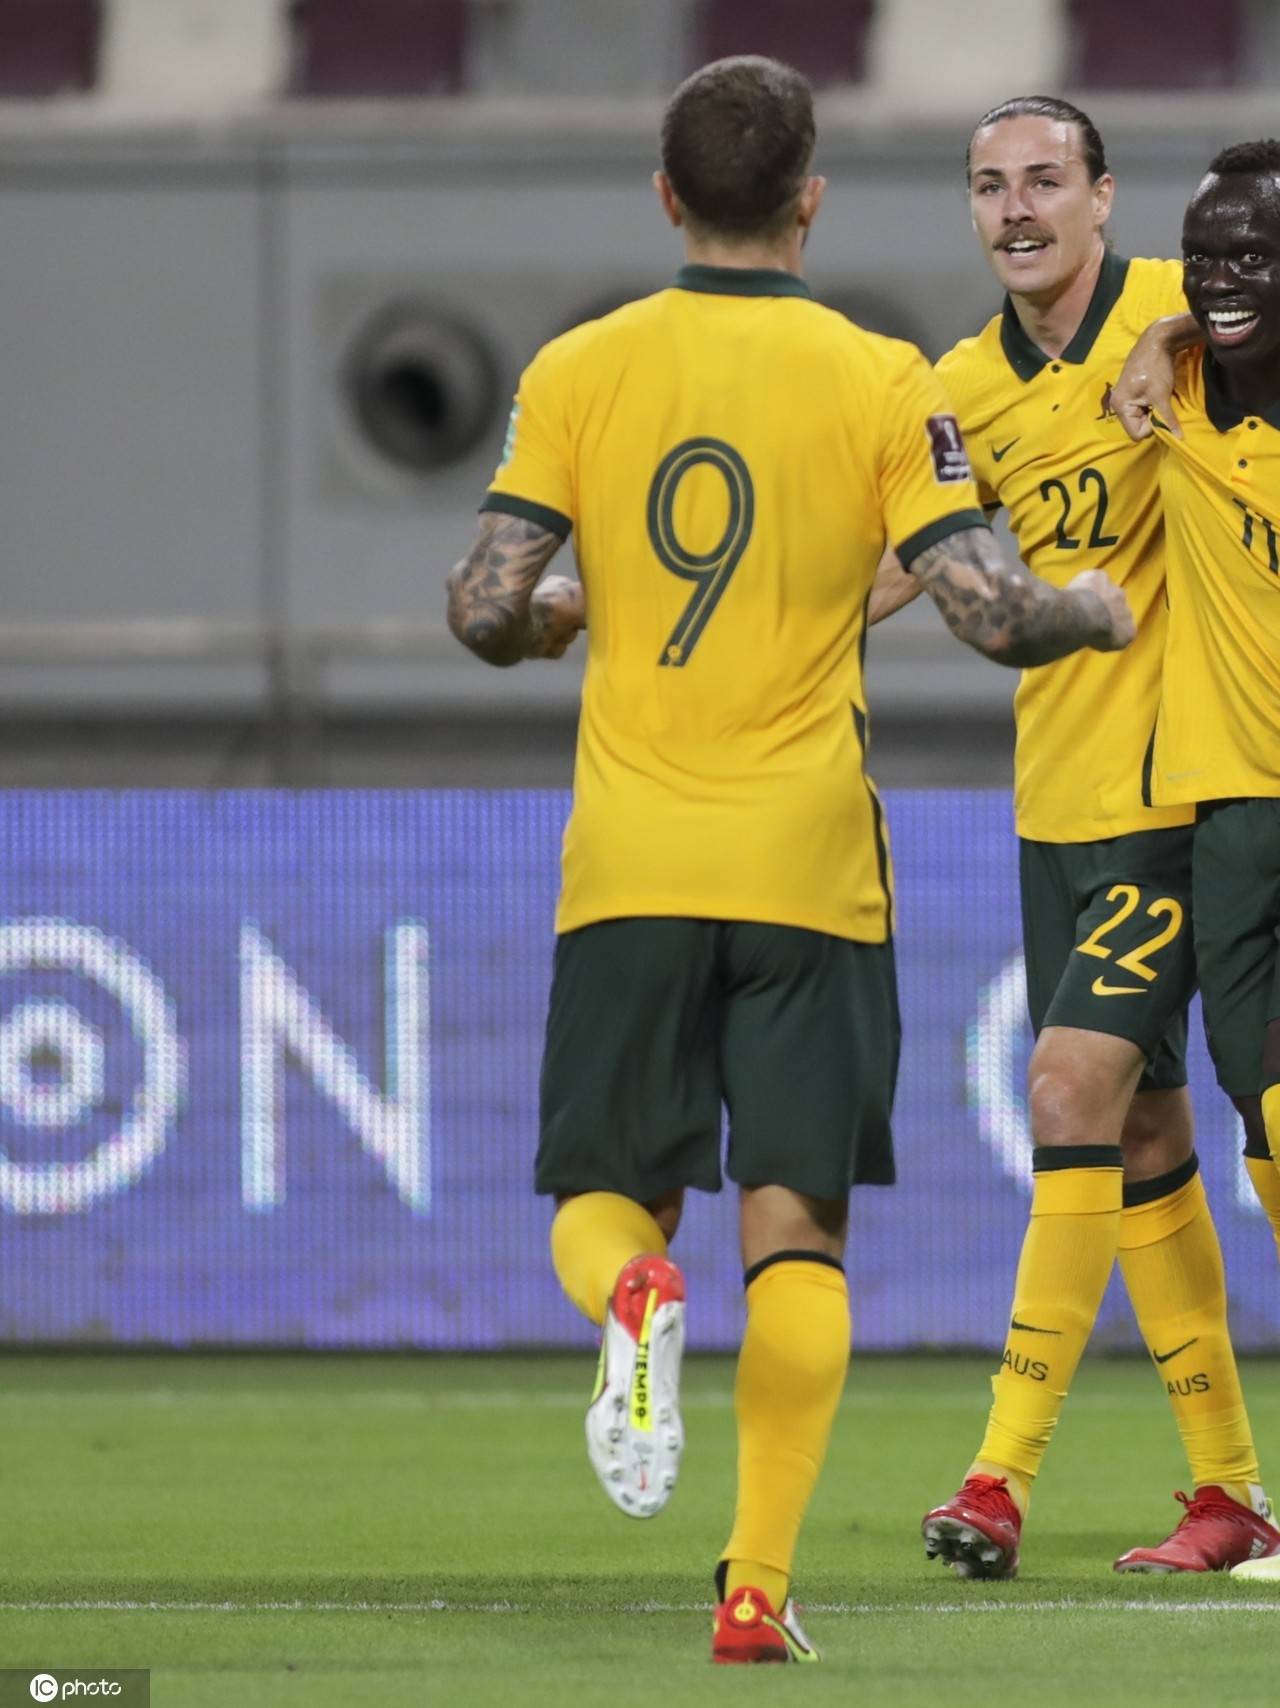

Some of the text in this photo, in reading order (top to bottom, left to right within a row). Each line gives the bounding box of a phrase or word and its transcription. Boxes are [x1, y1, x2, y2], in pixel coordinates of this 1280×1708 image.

[1040, 467, 1120, 549] 22
[647, 436, 755, 667] 9
[1076, 884, 1183, 982] 22
[635, 1341, 649, 1418] TIEMPO
[1002, 1348, 1049, 1382] AUS
[1167, 1373, 1210, 1397] AUS
